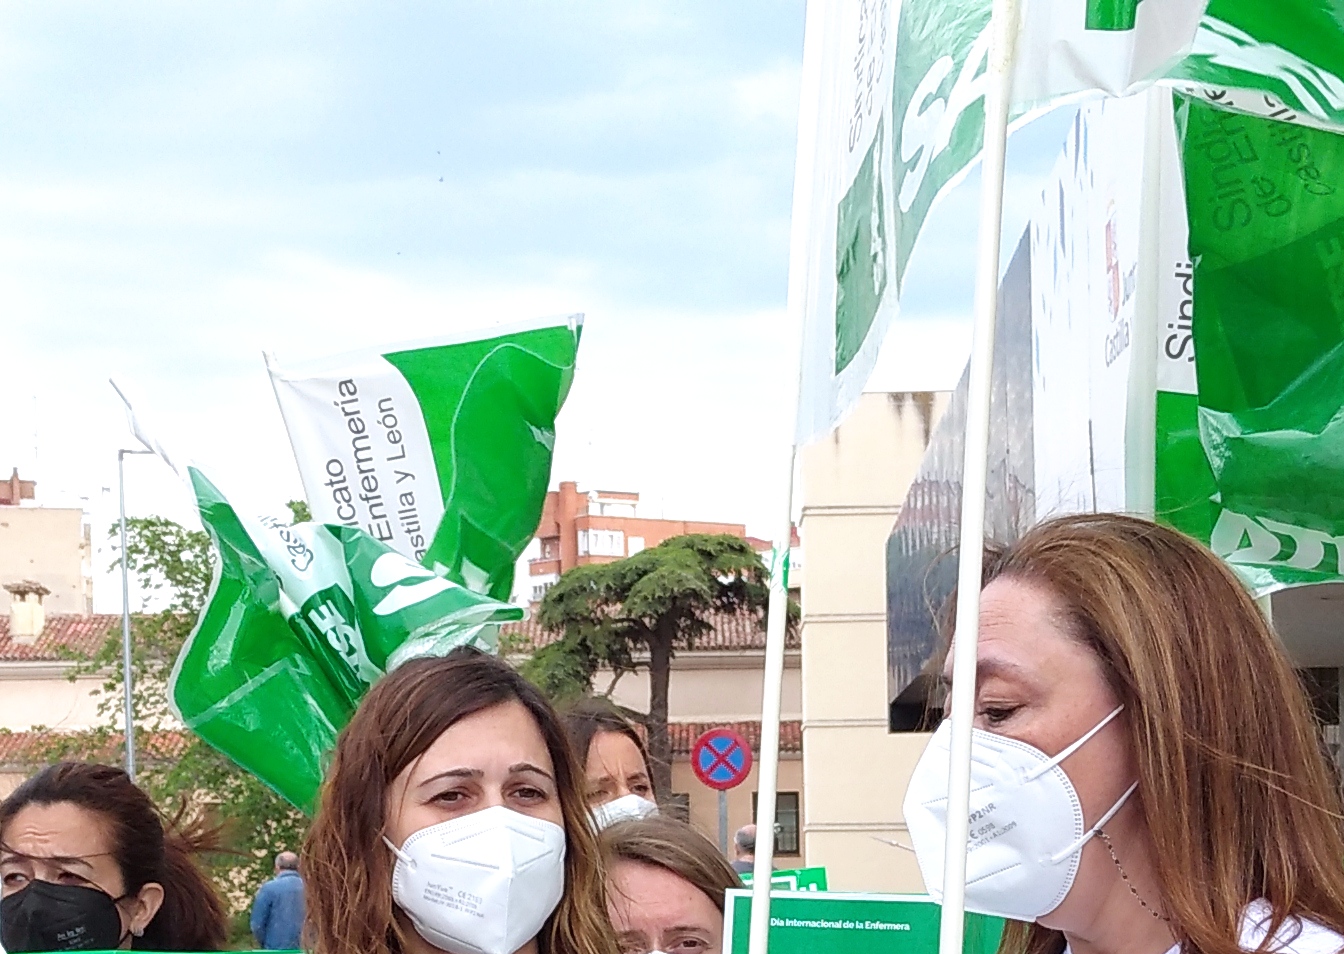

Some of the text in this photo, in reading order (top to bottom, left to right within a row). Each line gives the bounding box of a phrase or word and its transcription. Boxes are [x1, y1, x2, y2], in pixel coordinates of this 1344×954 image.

[1165, 262, 1195, 362] Sindi
[338, 378, 394, 541] Enfermería
[376, 397, 427, 563] astilla y León
[770, 917, 910, 931] Día Internacional de la Enfermera
